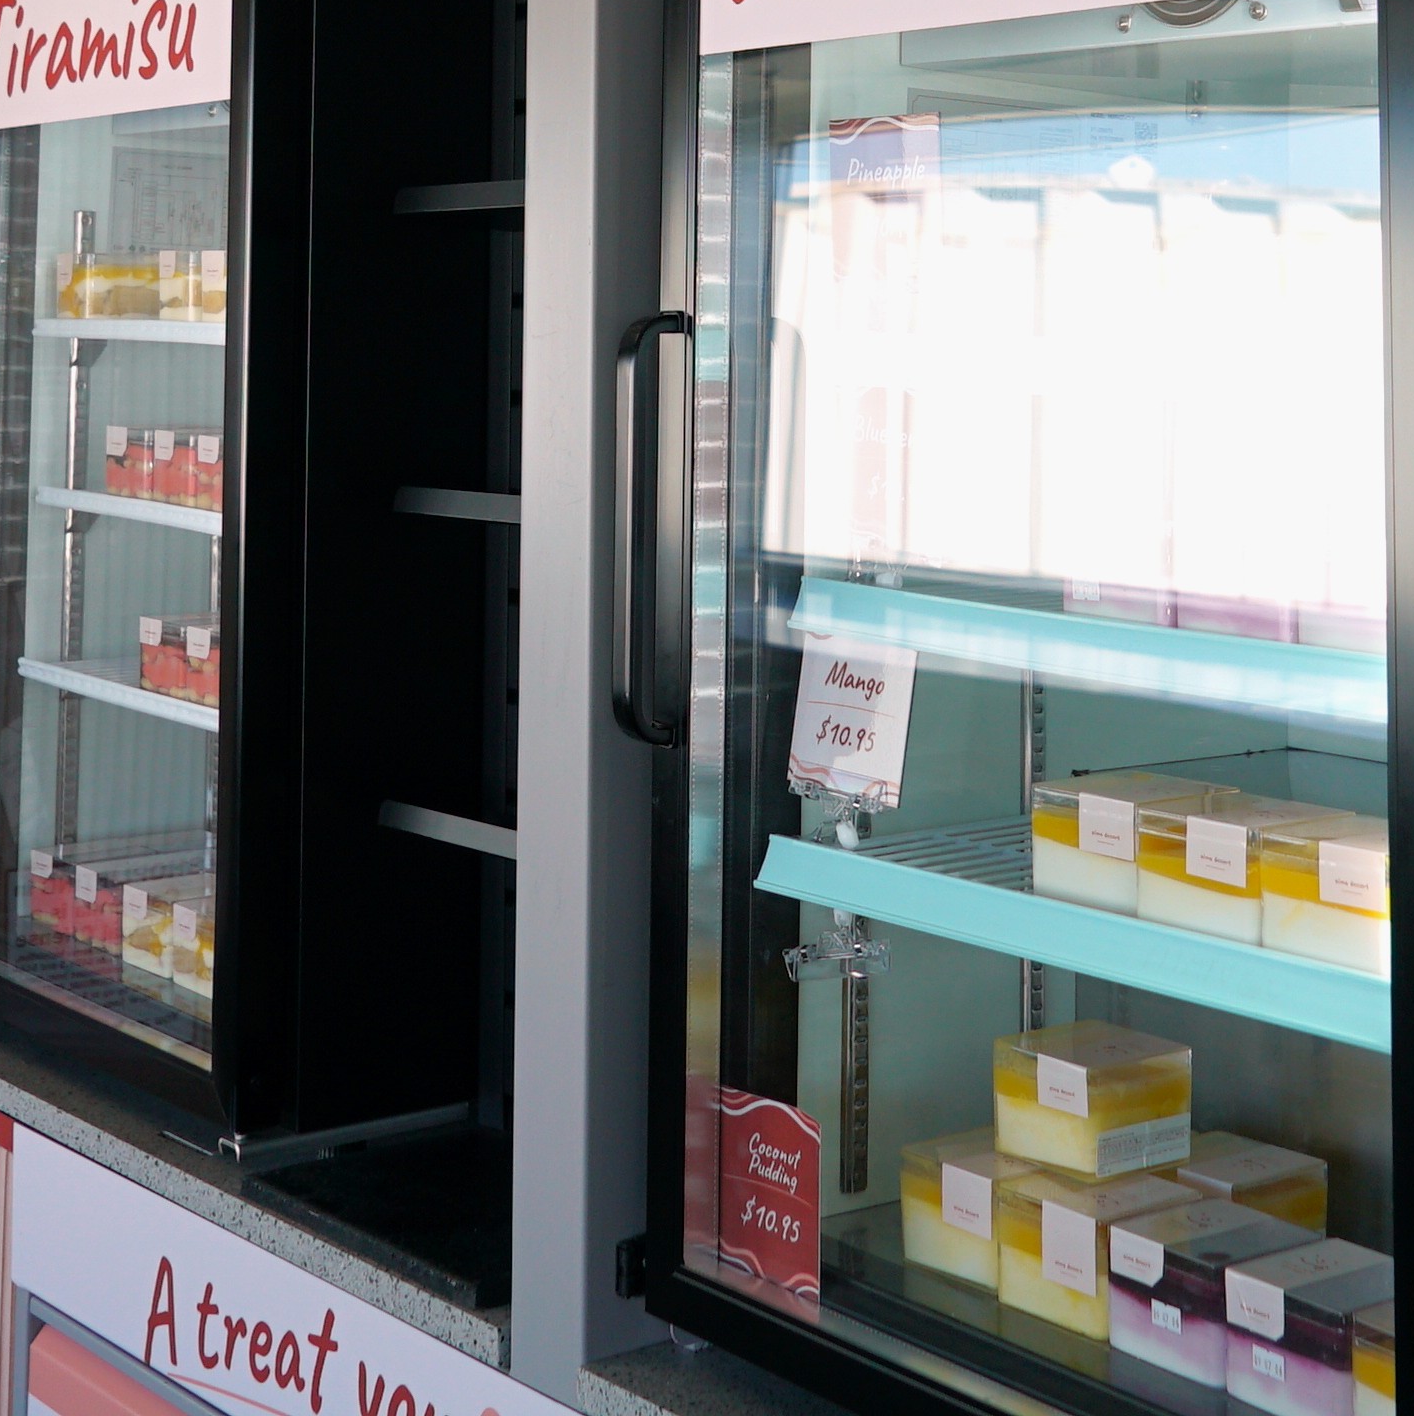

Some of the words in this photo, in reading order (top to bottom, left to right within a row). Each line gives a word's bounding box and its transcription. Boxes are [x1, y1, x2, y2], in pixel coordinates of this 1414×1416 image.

[846, 154, 926, 192] Pineapple
[825, 661, 885, 701] Mango
[816, 714, 876, 752] $10.95
[749, 1132, 801, 1169] Coconut
[748, 1153, 798, 1194] Pudding
[740, 1195, 801, 1242] $10.95
[143, 1256, 178, 1367] A
[196, 1282, 339, 1414] treat
[359, 1360, 449, 1416] yo
